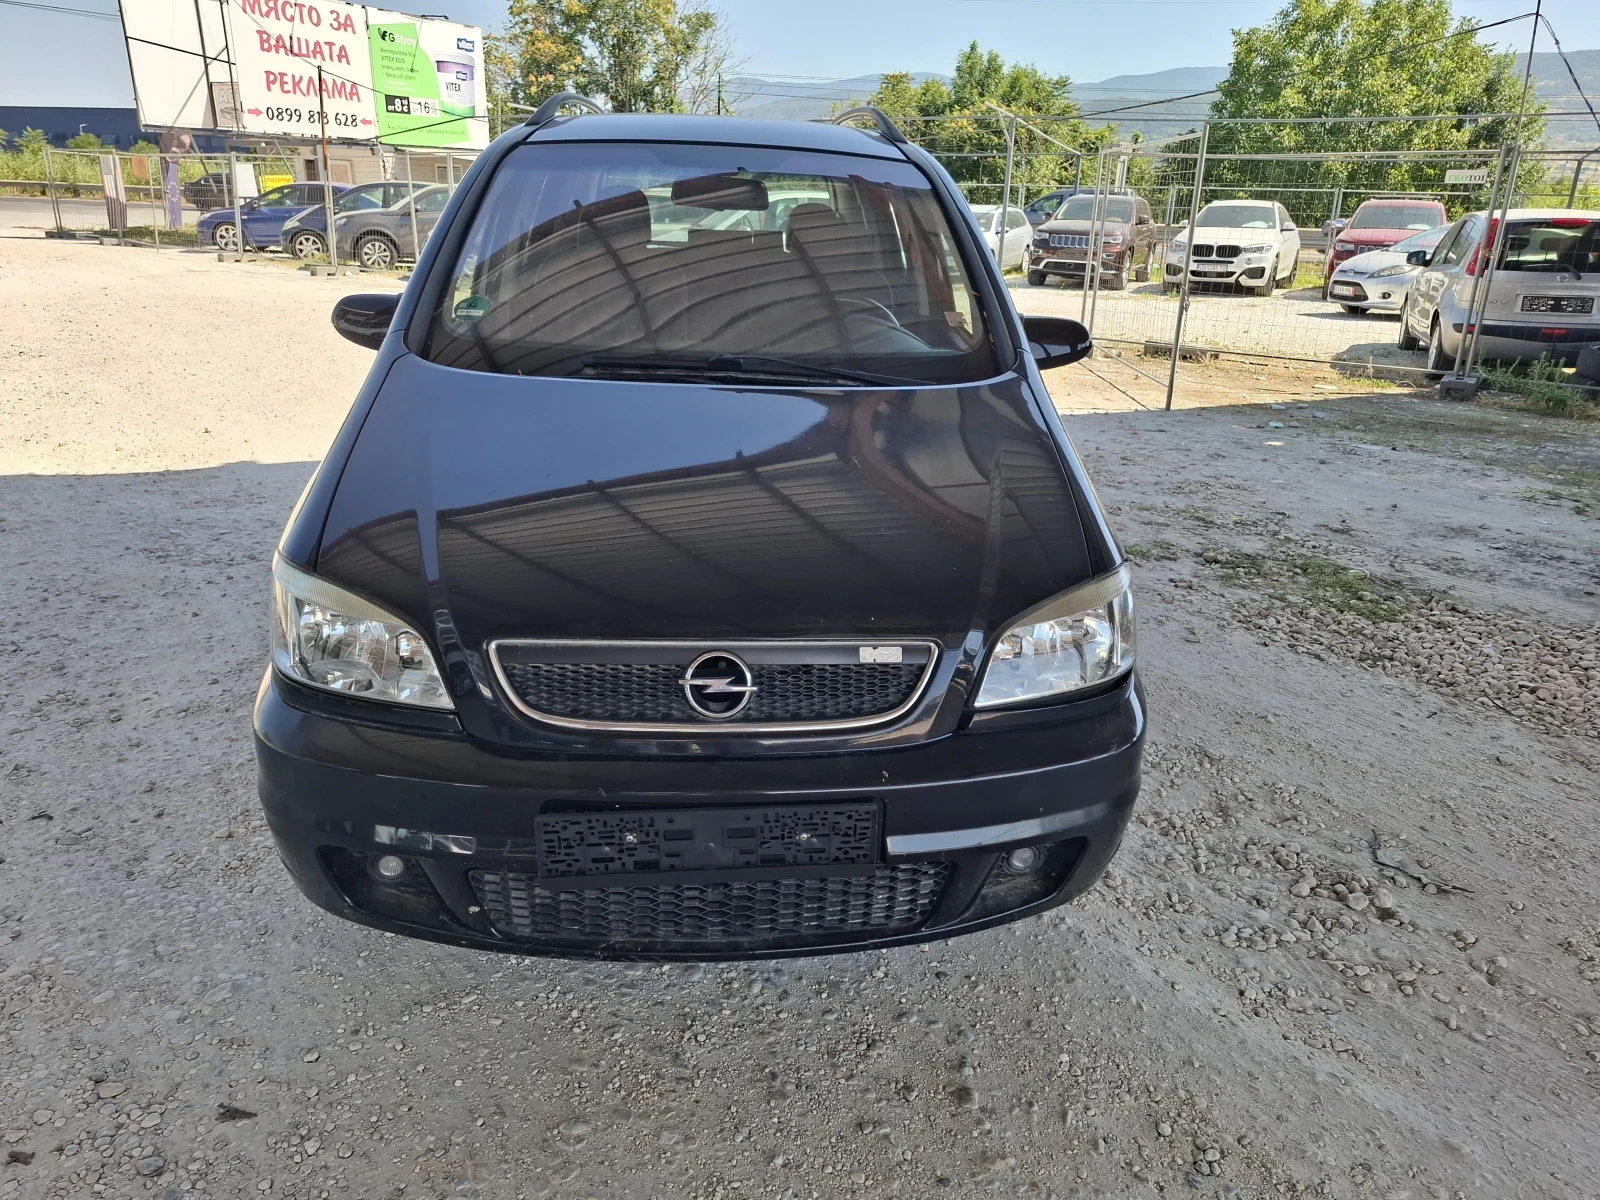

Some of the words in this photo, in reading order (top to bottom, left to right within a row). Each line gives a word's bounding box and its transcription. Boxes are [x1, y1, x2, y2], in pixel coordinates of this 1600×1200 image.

[242, 0, 321, 27] МЯСТО
[329, 10, 357, 35] ЗА
[256, 29, 351, 66] ВАШАТА
[264, 70, 362, 103] РЕКЛАМА
[445, 81, 462, 92] VITEX
[266, 106, 302, 123] 0899
[334, 112, 358, 127] 628
